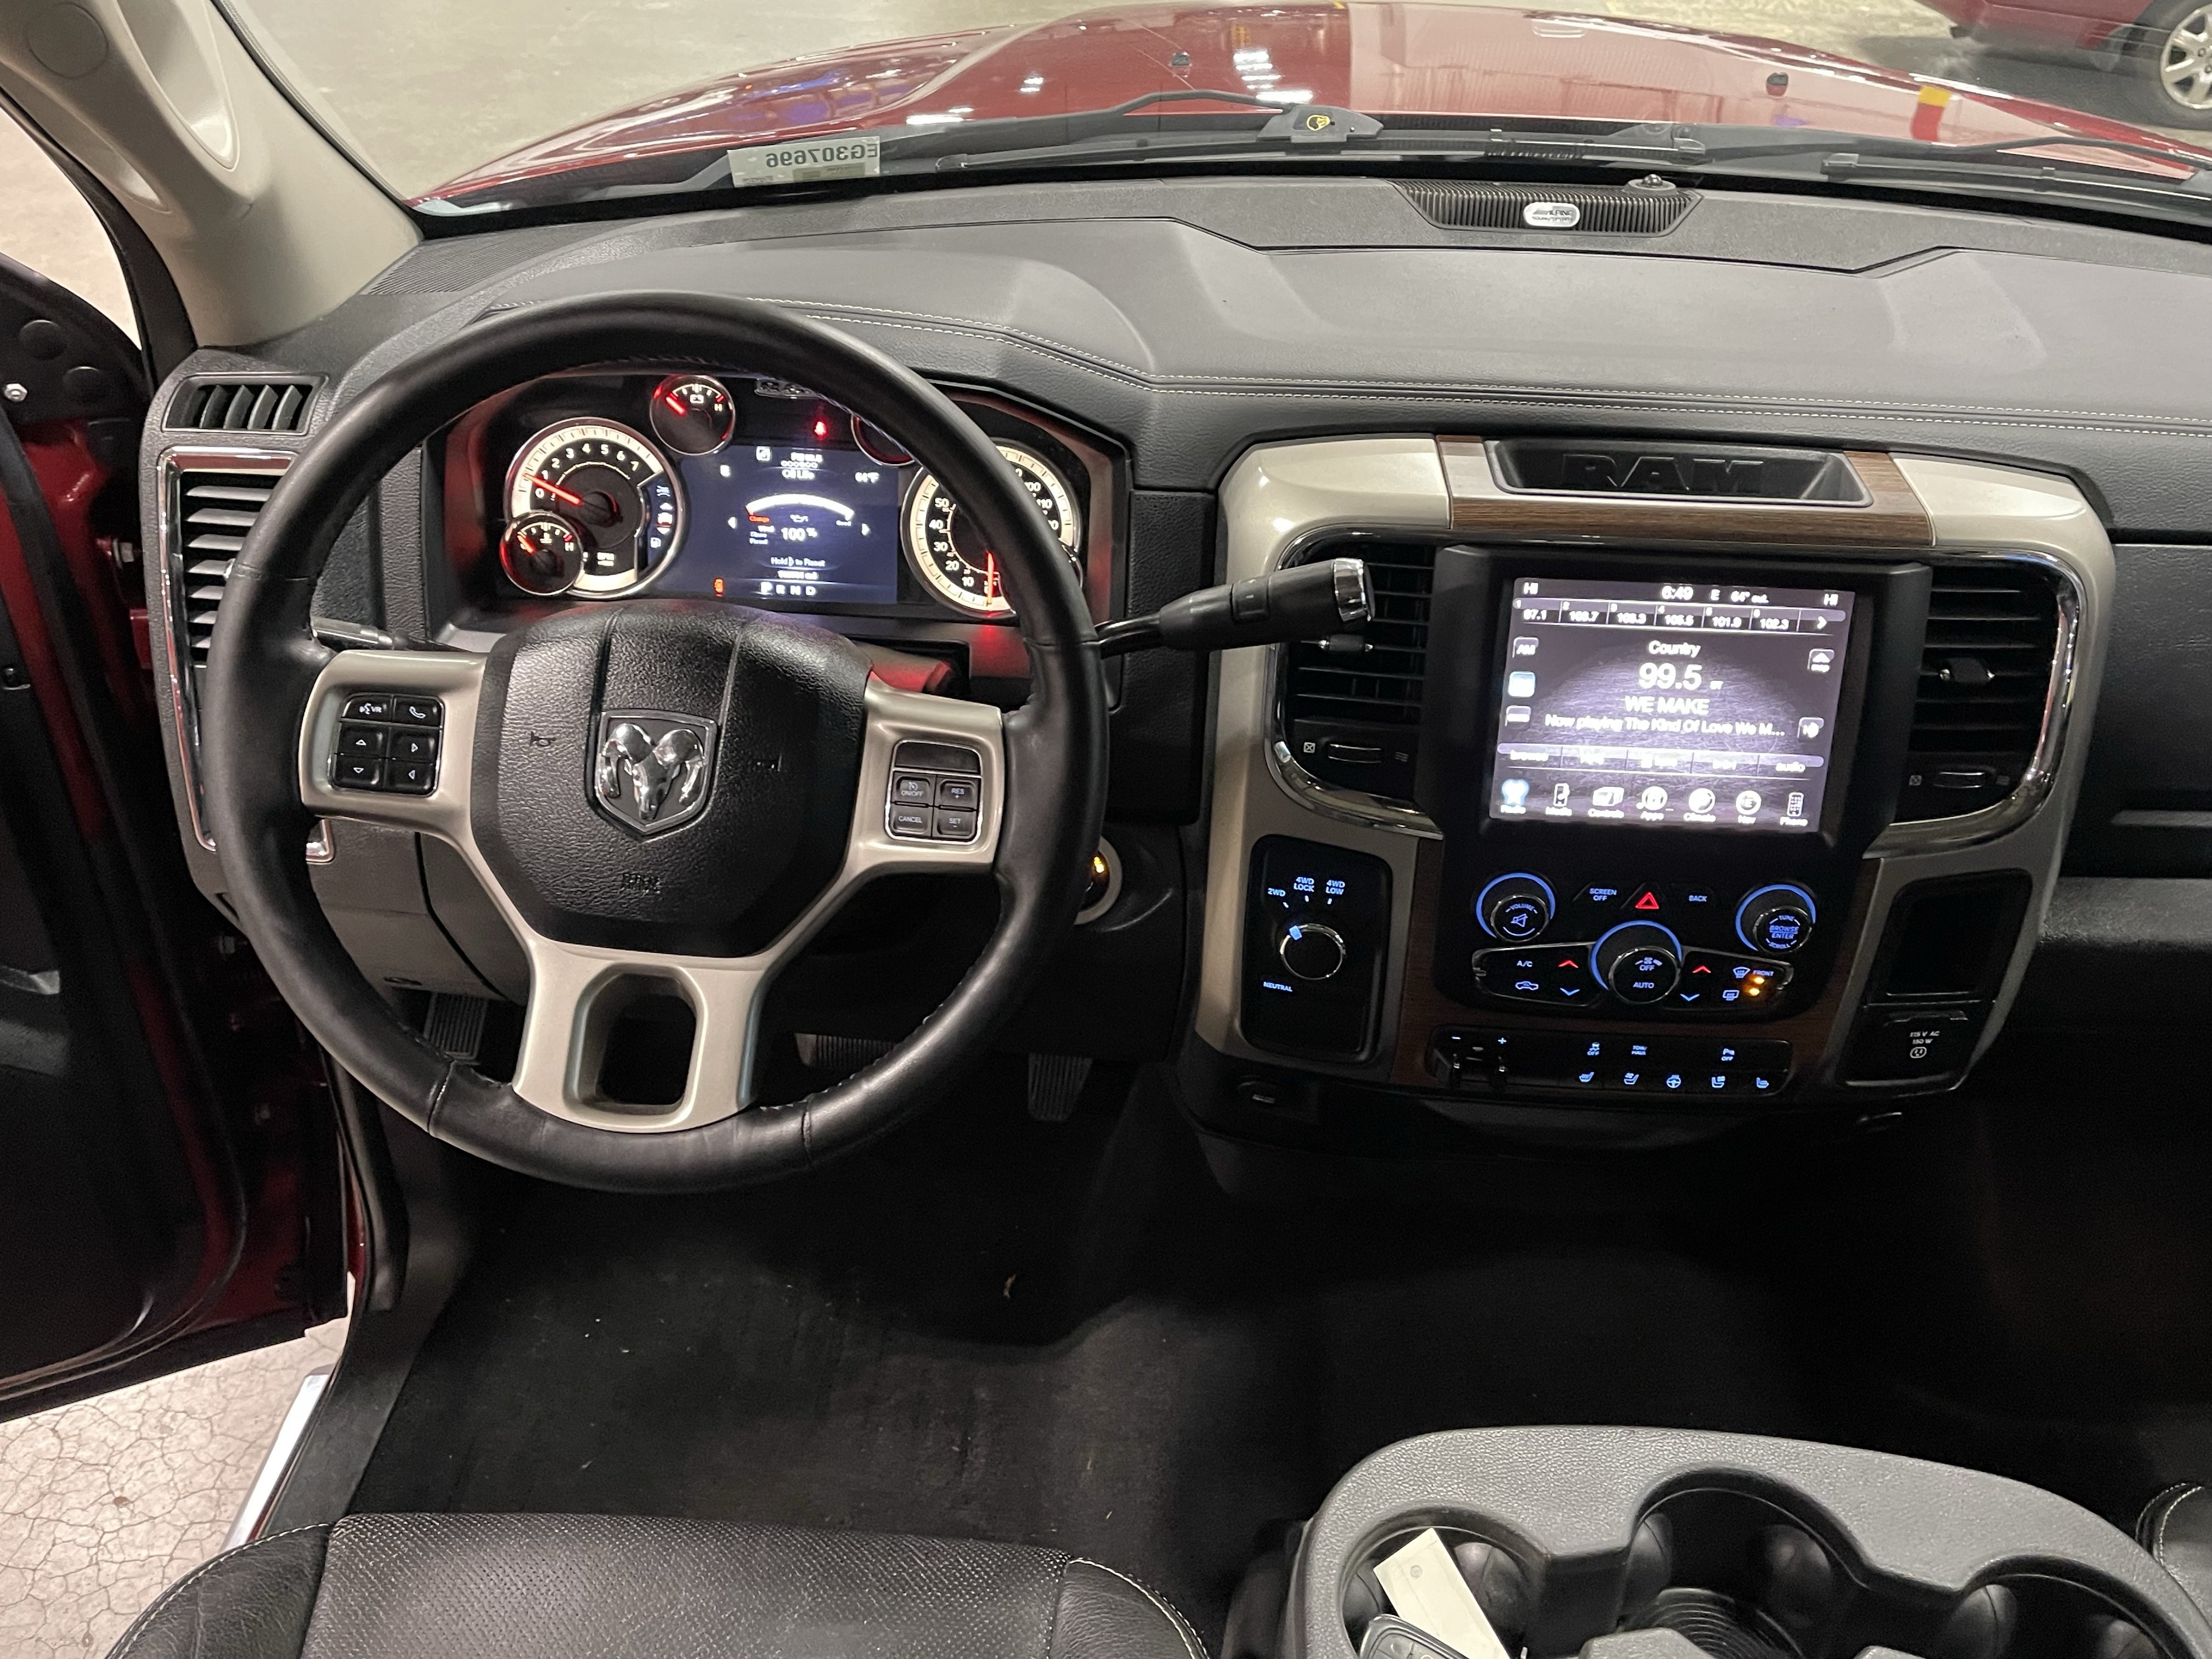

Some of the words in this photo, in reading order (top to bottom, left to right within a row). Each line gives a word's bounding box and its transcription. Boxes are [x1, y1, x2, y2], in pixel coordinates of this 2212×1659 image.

[566, 448, 574, 458] 3
[582, 443, 590, 454] 4
[601, 444, 609, 455] 5
[617, 451, 625, 461] 6
[552, 458, 560, 468] 2
[630, 461, 639, 471] 7
[535, 488, 545, 498] 0
[934, 498, 950, 508] 50
[928, 519, 944, 529] 40
[565, 541, 574, 551] H
[933, 541, 948, 552] 30
[945, 560, 960, 571] 20
[962, 577, 974, 587] 10
[775, 584, 786, 595] R
[805, 586, 817, 596] D
[1710, 589, 1721, 601] E
[1823, 593, 1838, 606] HI
[1658, 605, 1665, 614] 4
[1648, 640, 1701, 658] Country
[1638, 662, 1703, 691] 99.5
[1624, 696, 1655, 712] WE
[1657, 697, 1711, 715] MAKE
[1544, 714, 1576, 727] Now
[1576, 715, 1623, 733] playing
[1624, 716, 1650, 731] The
[1651, 718, 1682, 733] Kind
[1682, 719, 1701, 733] Of
[1701, 720, 1733, 734] Love
[1735, 721, 1757, 736] We
[898, 815, 923, 823] CANCEL
[1295, 876, 1315, 885] 4WD
[1326, 879, 1346, 888] 4WD
[1267, 887, 1286, 898] 2WD
[1293, 883, 1315, 892] LOCK
[1325, 887, 1344, 895] LOW
[1589, 888, 1617, 896] SCREEN
[1509, 902, 1535, 911] VOLUME
[1769, 925, 1799, 934] BROWSE
[1263, 981, 1293, 992] NEUTRAL
